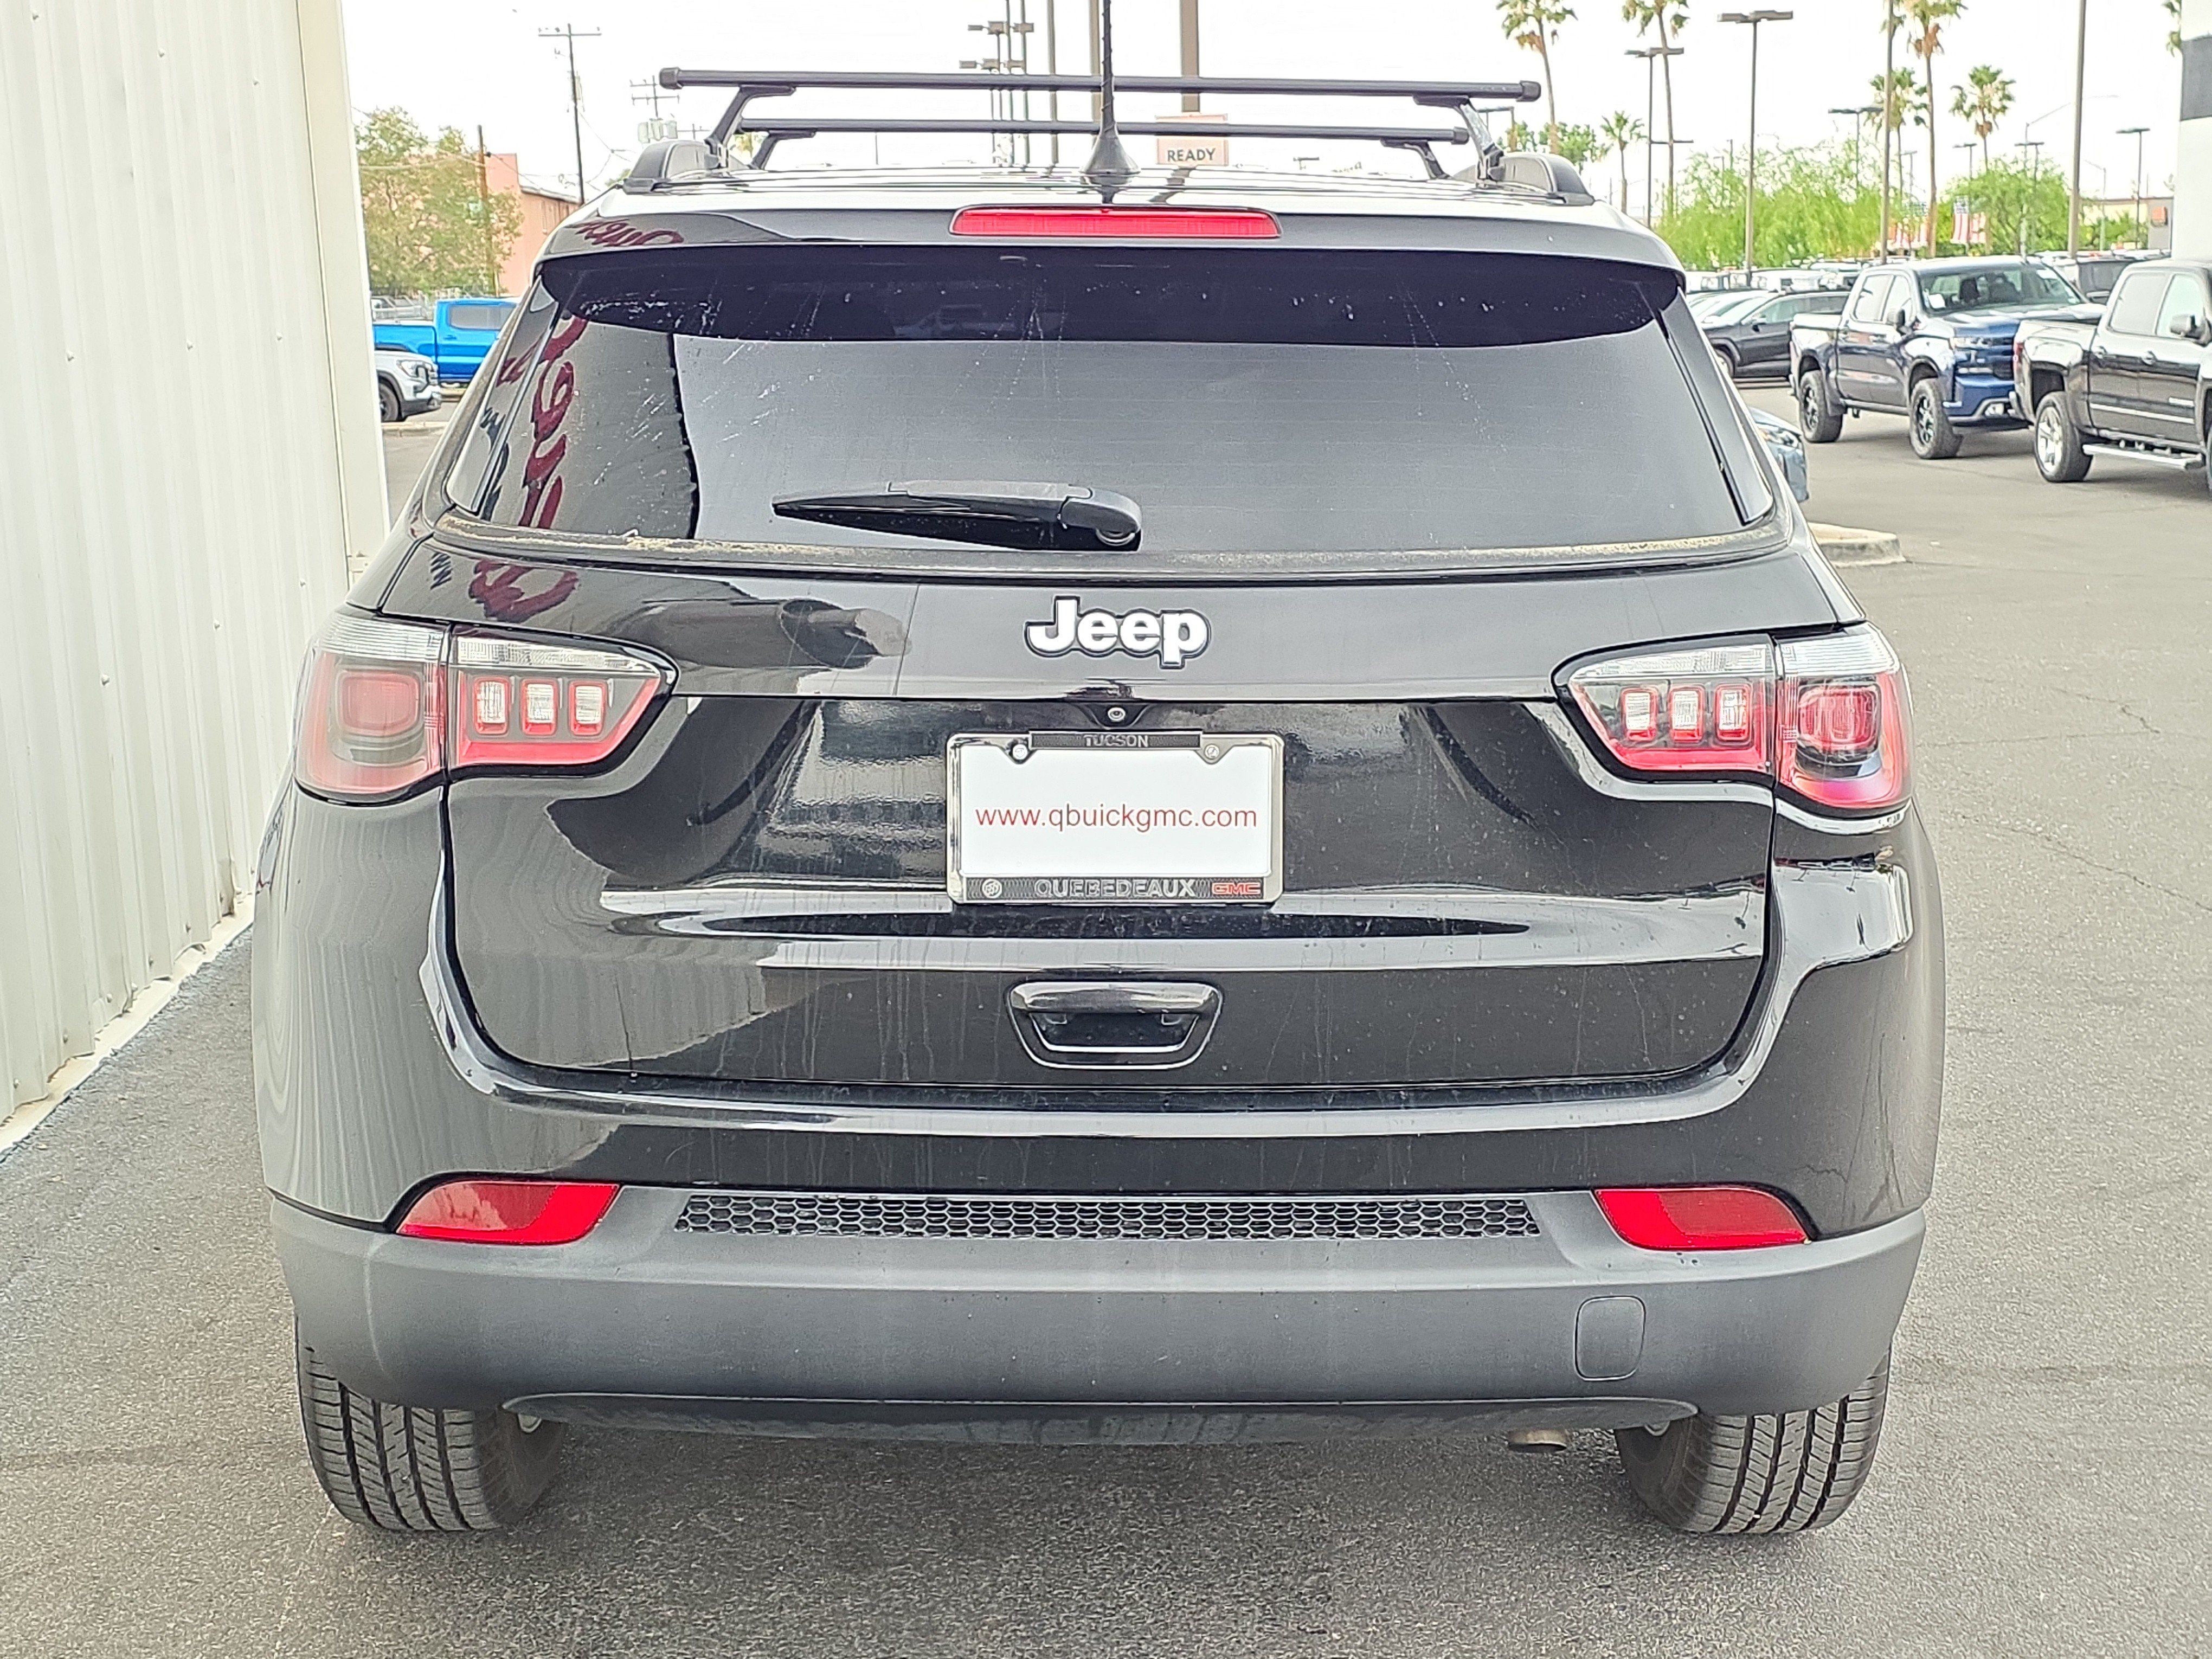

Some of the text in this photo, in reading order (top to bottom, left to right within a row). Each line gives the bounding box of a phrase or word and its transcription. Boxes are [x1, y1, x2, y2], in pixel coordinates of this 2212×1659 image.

[1167, 147, 1216, 162] READY
[1025, 595, 1211, 669] Jeep
[1084, 734, 1149, 747] TUCSON
[975, 804, 1257, 832] www.qbuickgmc.com
[1034, 879, 1262, 898] QUEBEDEAUX GMC
